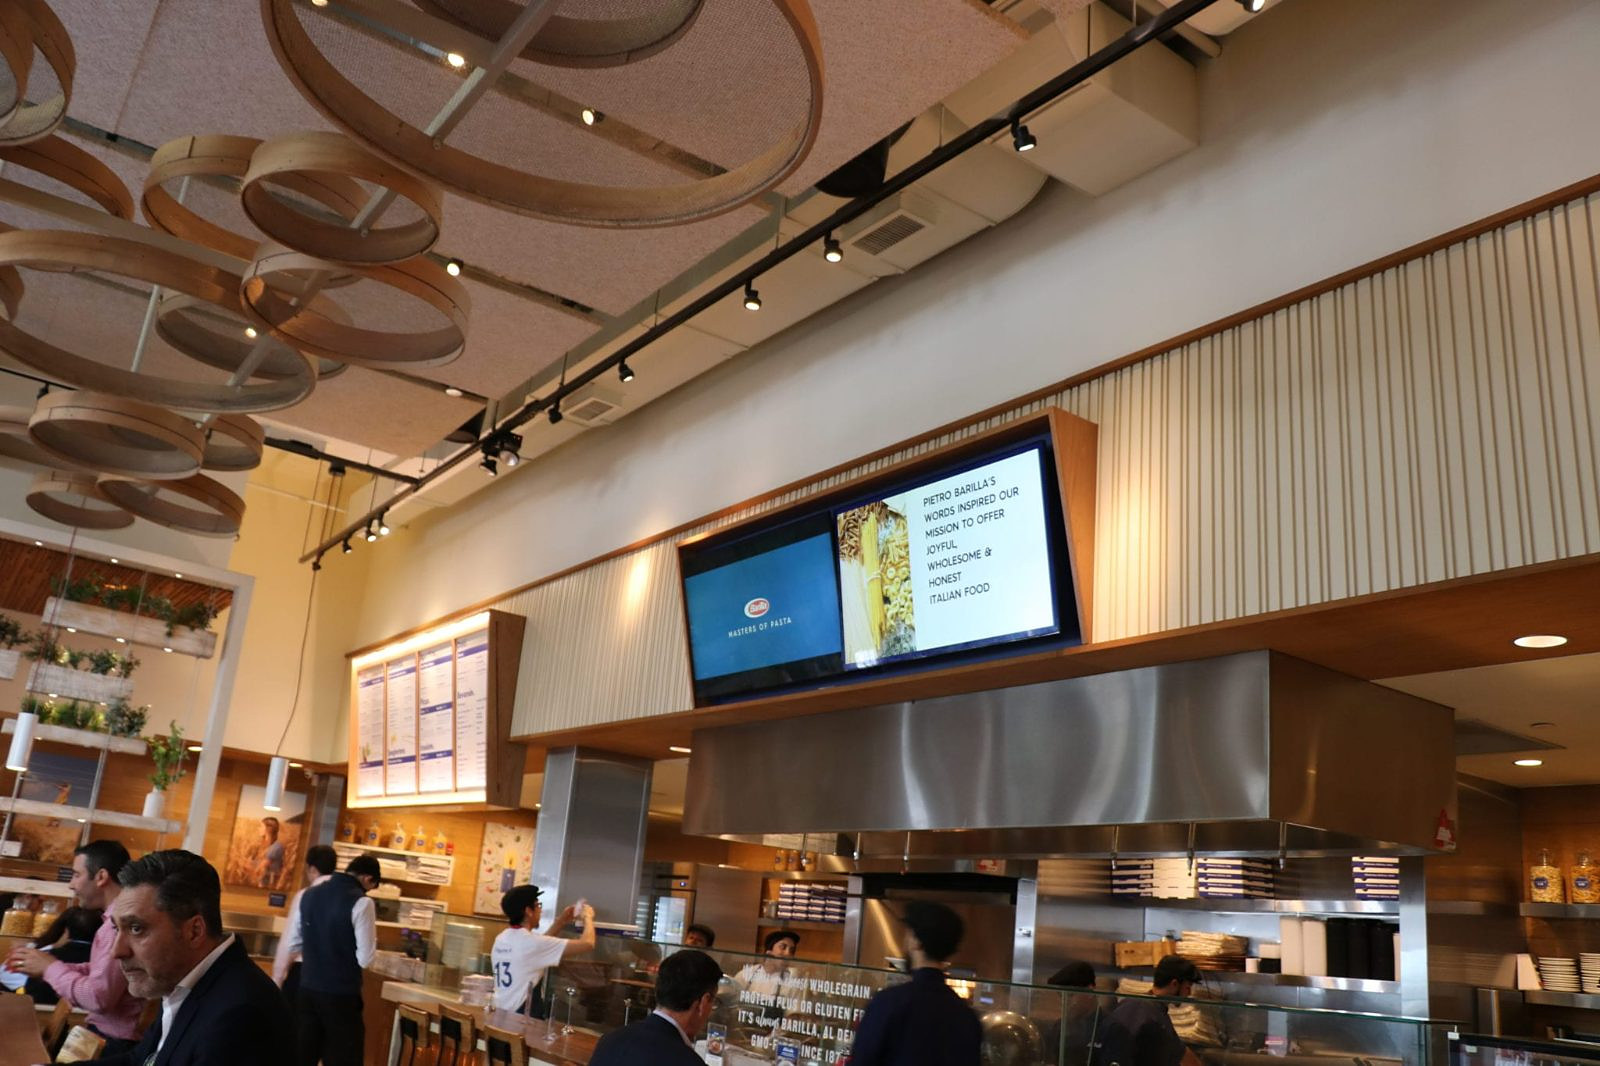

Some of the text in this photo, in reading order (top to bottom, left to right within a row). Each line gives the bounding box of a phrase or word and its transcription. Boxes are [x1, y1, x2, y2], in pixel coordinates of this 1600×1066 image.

[923, 476, 996, 507] PIETRO BARILLA'S
[924, 486, 1019, 523] WORDS INSPIRED OUR
[925, 508, 1005, 539] MISSION TO OFFER
[927, 546, 992, 572] WHOLESOME &
[928, 571, 962, 588] HONEST
[929, 582, 990, 605] ITALIAN FOOD
[728, 616, 792, 638] MASTERS OF PASTA
[495, 961, 512, 987] 13
[740, 990, 776, 1008] PROTEIN
[776, 996, 798, 1012] PLUS
[800, 1000, 812, 1014] OR
[814, 1002, 851, 1021] GLUTEN
[738, 1009, 754, 1024] IT'S
[822, 1024, 834, 1040] AL
[801, 1045, 822, 1061] INCE
